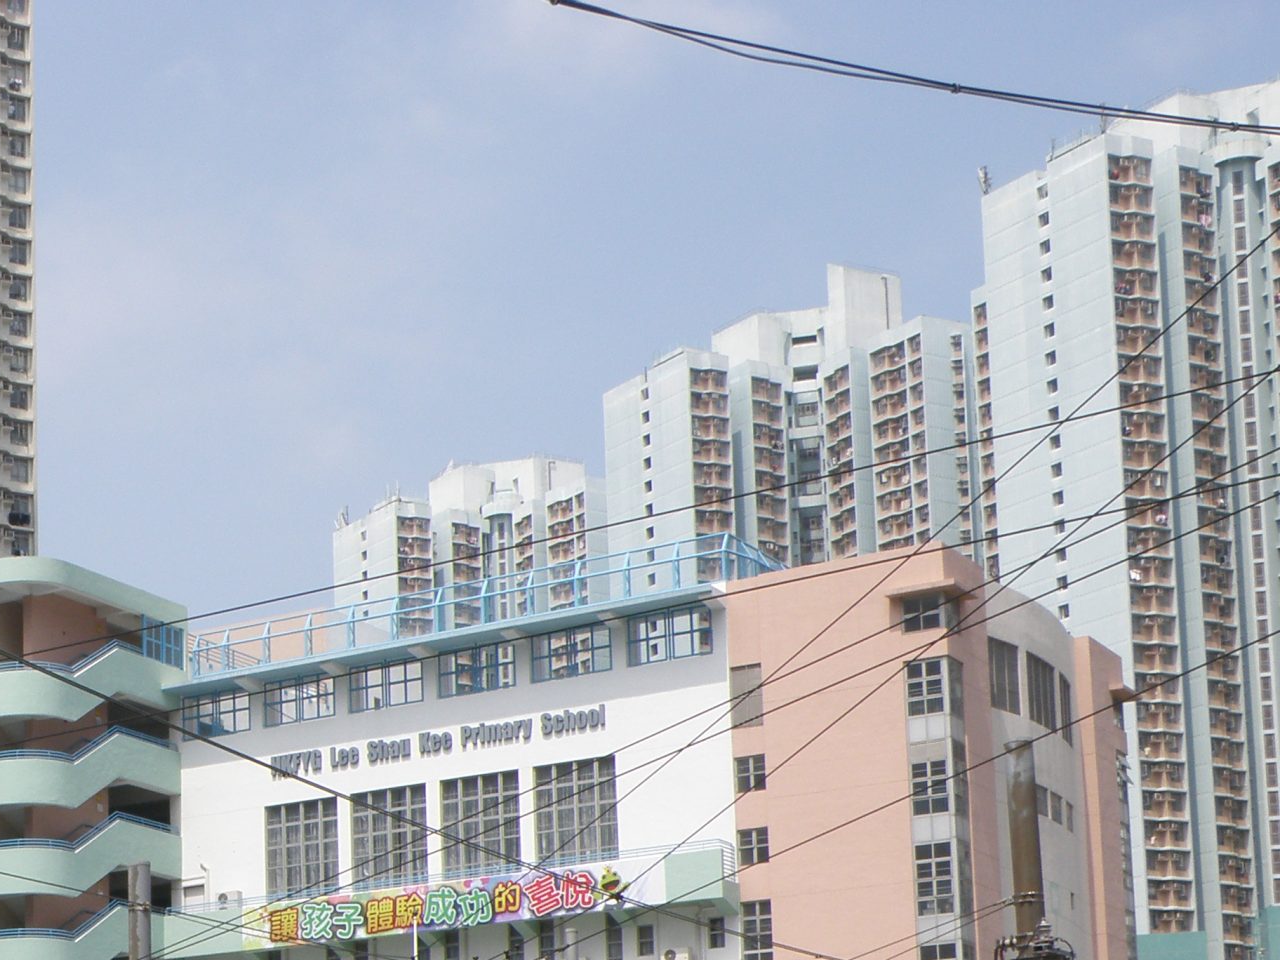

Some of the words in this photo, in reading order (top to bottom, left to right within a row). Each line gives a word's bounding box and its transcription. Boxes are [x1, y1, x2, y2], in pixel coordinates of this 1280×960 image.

[271, 749, 322, 780] HKFYG
[330, 746, 360, 769] Lee
[367, 738, 411, 764] Shau
[419, 731, 453, 755] Kee
[461, 718, 533, 748] Primary
[541, 704, 606, 736] School
[269, 871, 596, 943] 讓孩子體驗成功的喜悅
